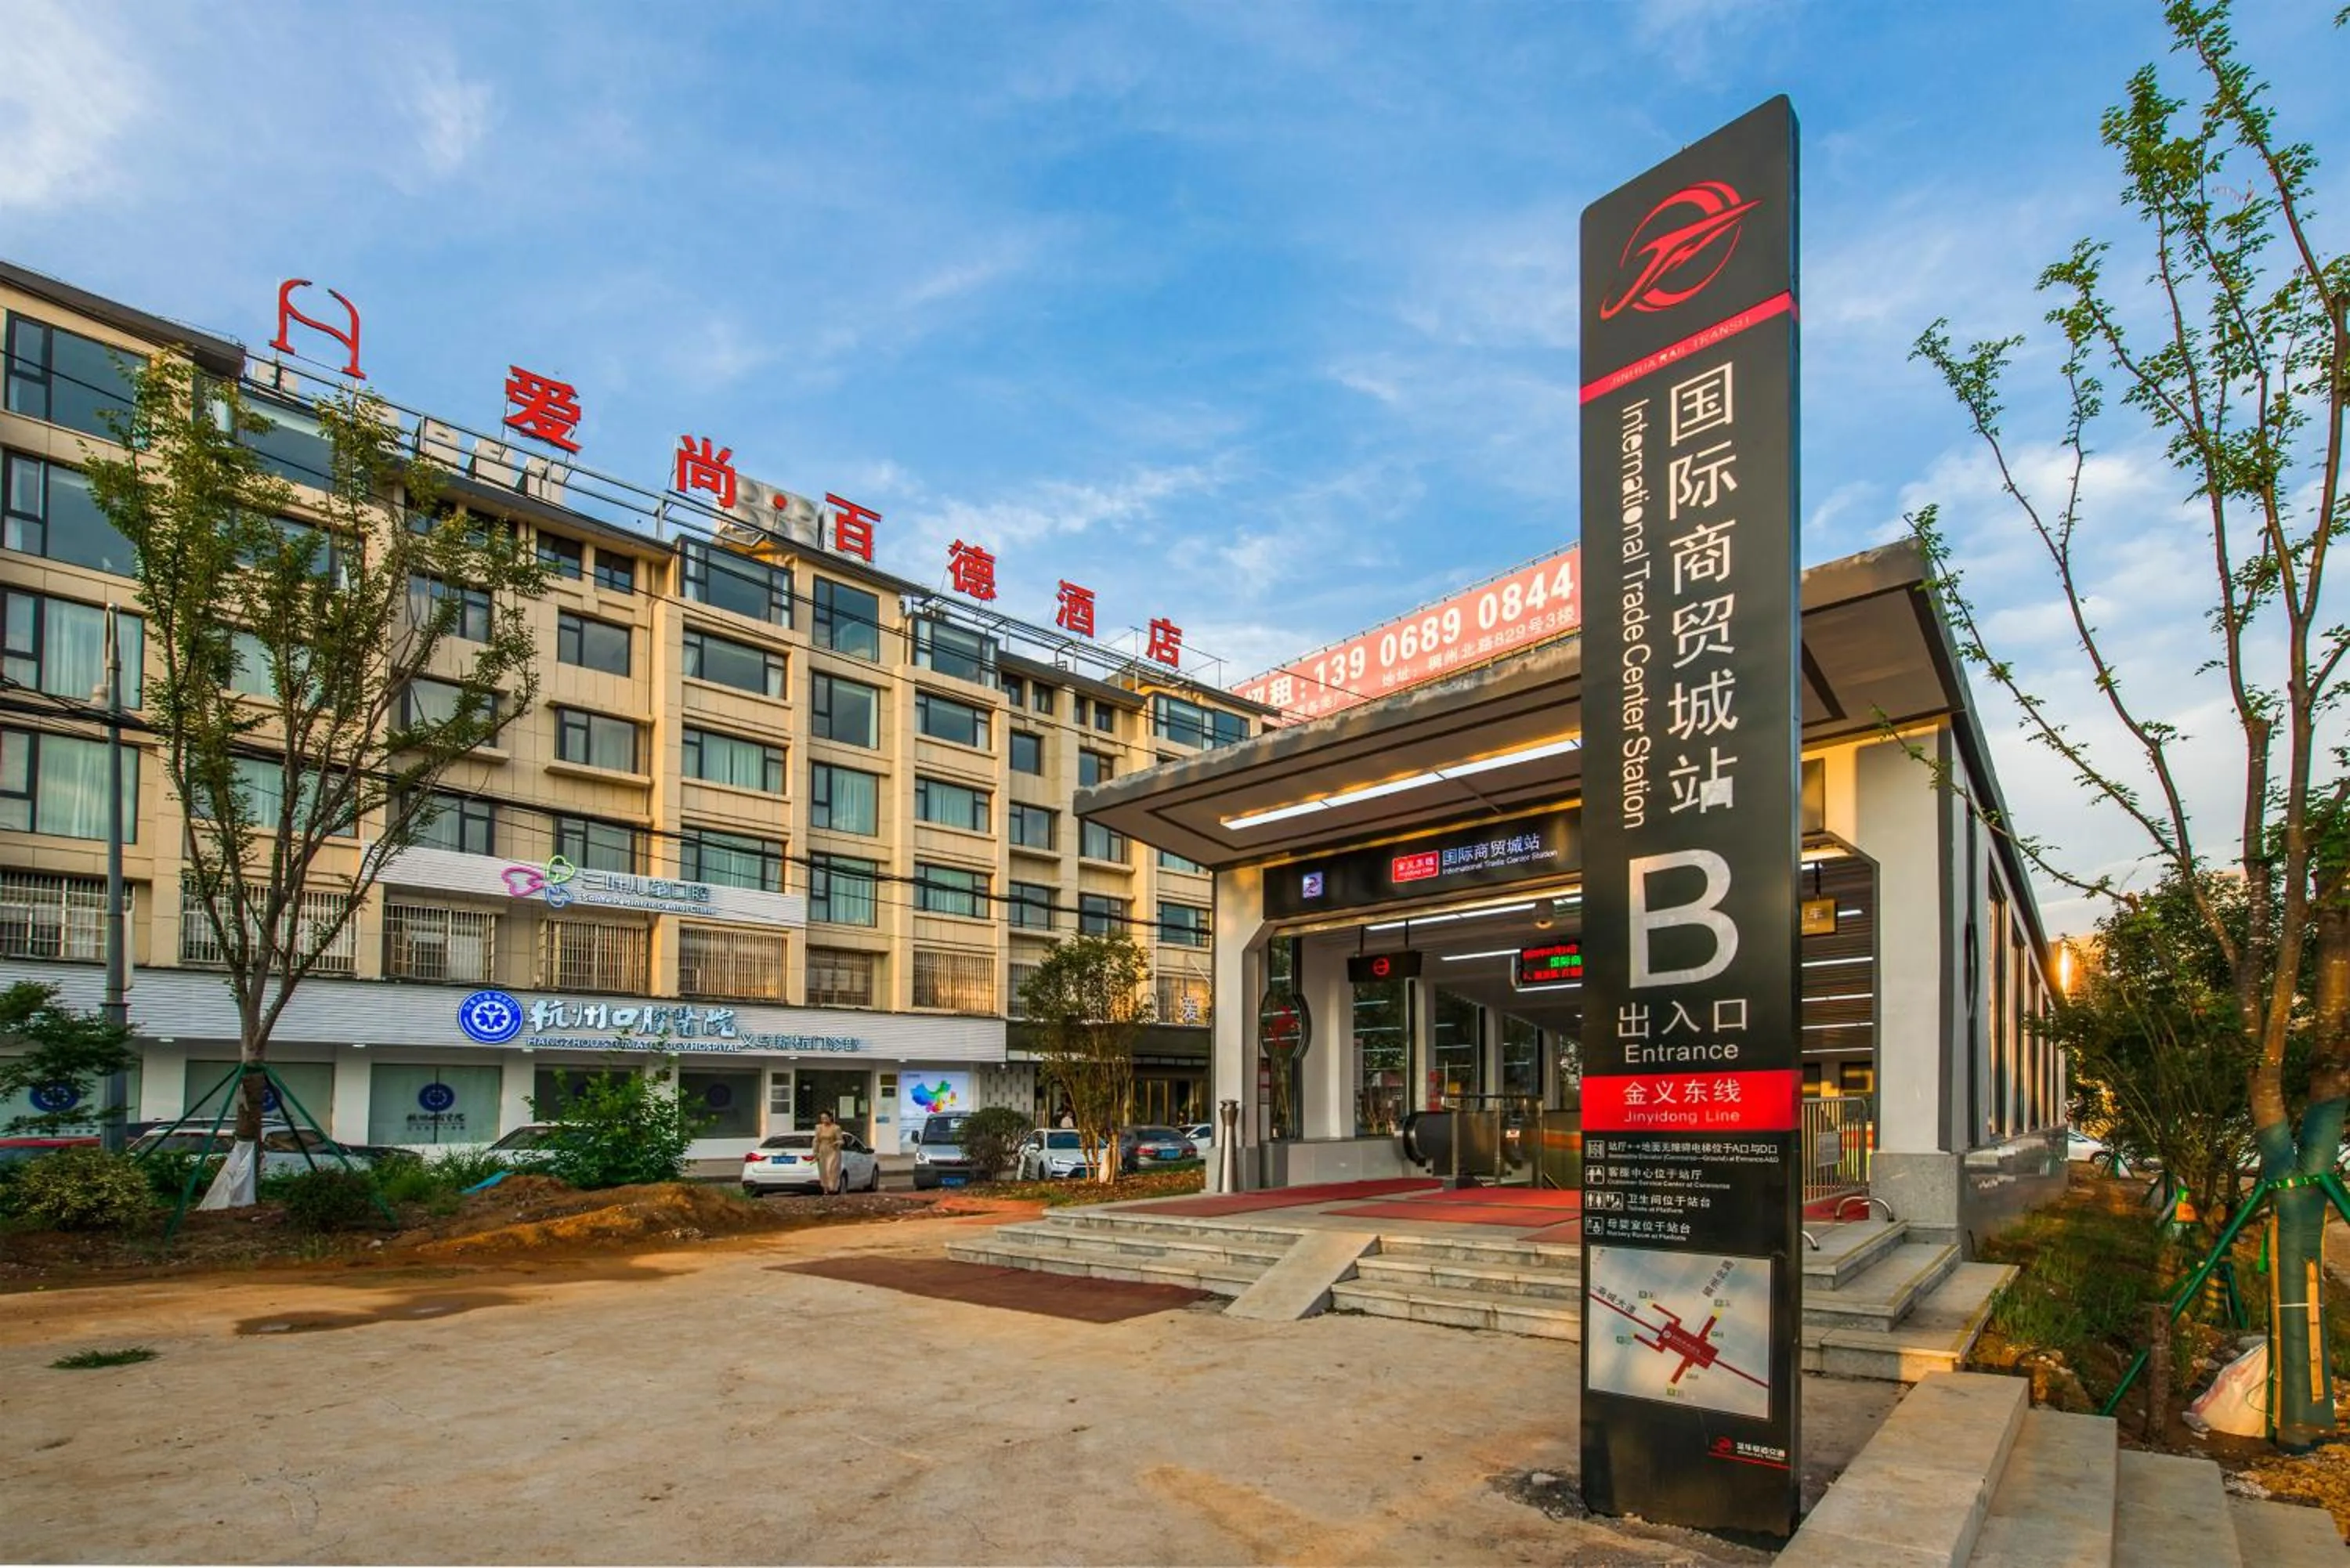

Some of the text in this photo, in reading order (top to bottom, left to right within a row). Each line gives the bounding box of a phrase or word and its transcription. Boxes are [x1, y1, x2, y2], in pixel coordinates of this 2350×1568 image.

[1668, 361, 1738, 814] 国际商贸城站
[1380, 607, 1462, 667] 0689
[1477, 561, 1574, 630] 0844
[1622, 398, 1651, 829] International Trade Center Station
[1442, 833, 1540, 866] 国际商贸城站
[1629, 849, 1738, 989] B
[1618, 999, 1748, 1039] 出入口
[1625, 1042, 1739, 1064] Entrance
[1623, 1078, 1741, 1104] 金义东线
[1624, 1109, 1741, 1124] Jinyidong Line
